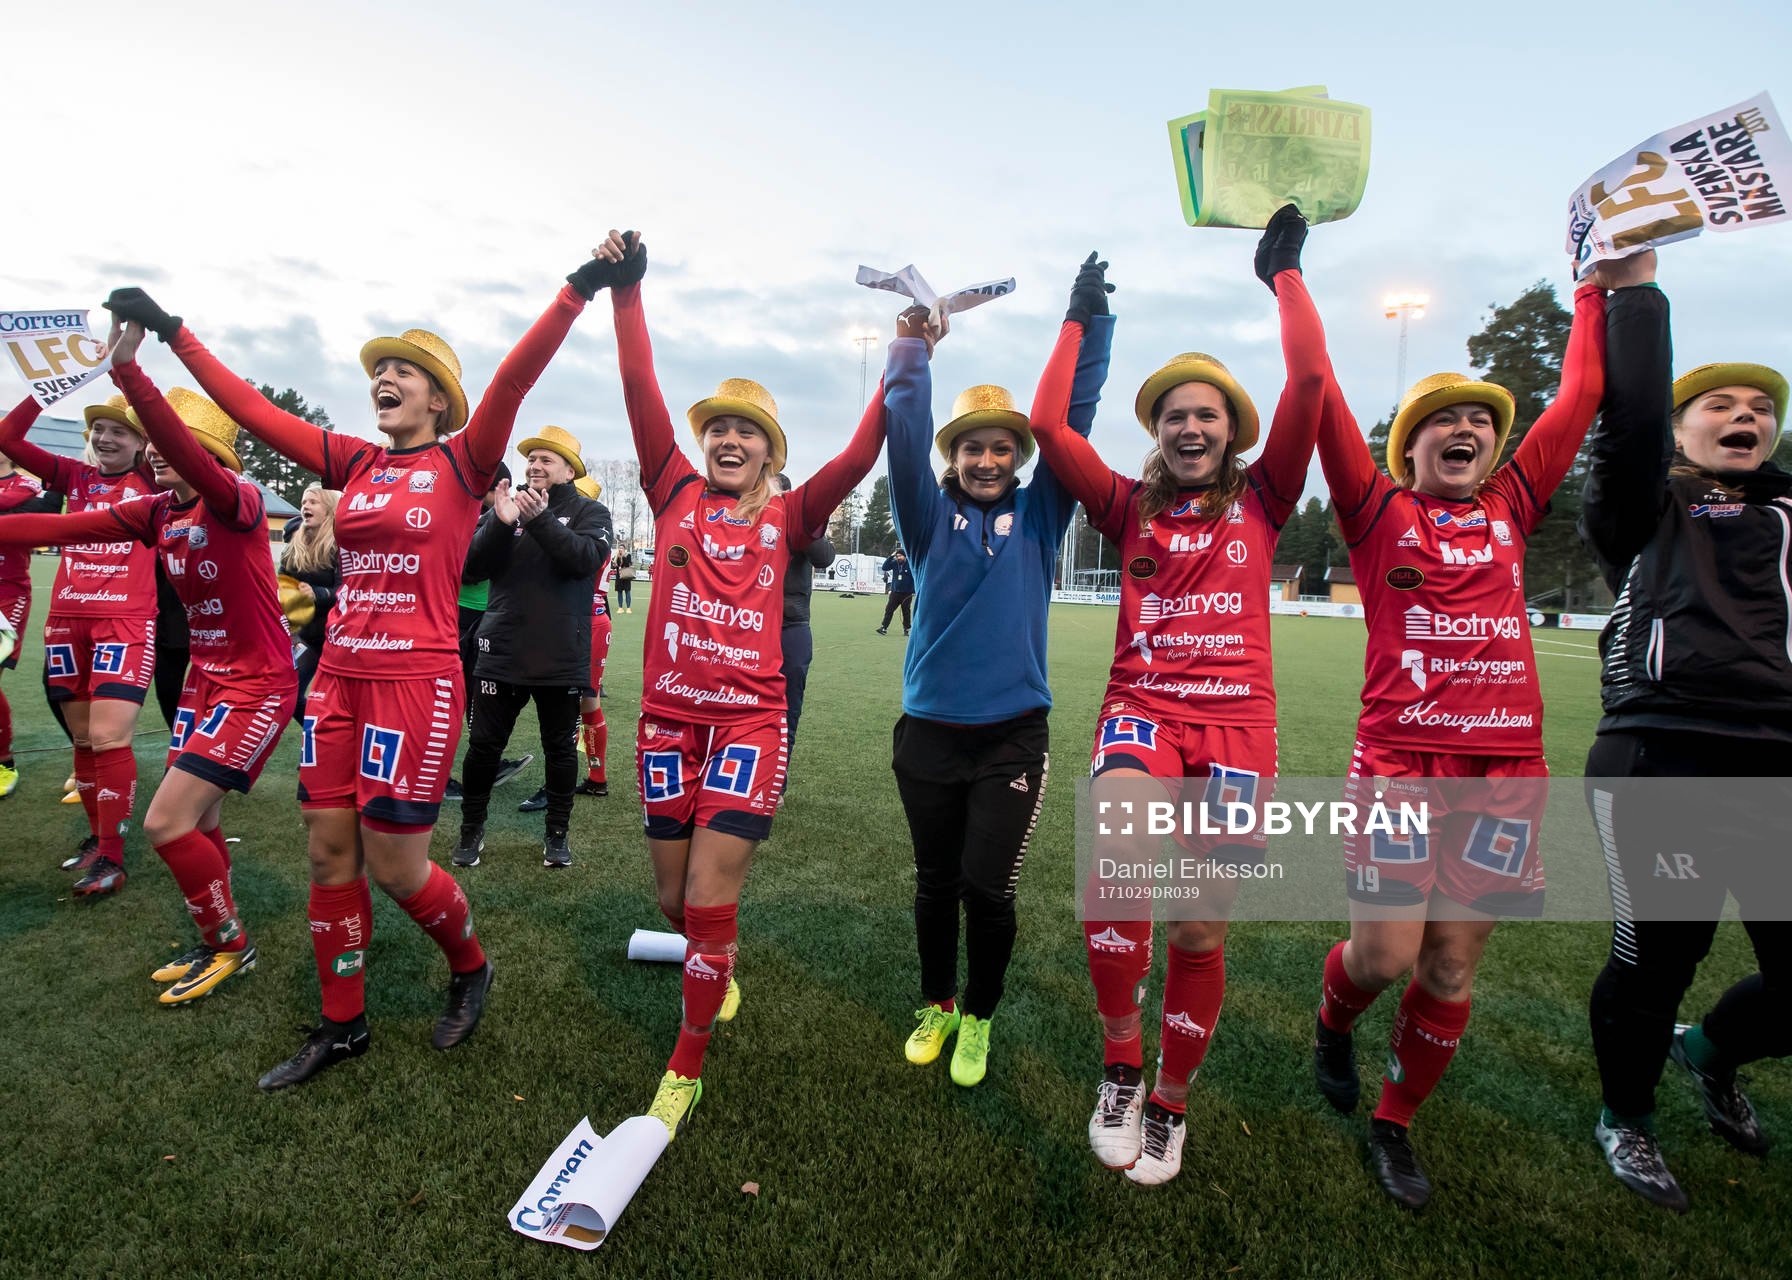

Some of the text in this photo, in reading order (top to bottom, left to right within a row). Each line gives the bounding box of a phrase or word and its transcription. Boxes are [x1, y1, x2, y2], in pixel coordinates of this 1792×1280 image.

[1670, 129, 1743, 225] SVENSKA
[1707, 117, 1786, 221] MÄSTARE
[0, 313, 83, 332] Corren
[8, 334, 100, 380] LFC
[352, 550, 420, 575] Botrygg
[58, 586, 128, 603] Korvgubbens
[689, 593, 764, 632] Botrygg
[1434, 613, 1520, 640] Botrygg
[328, 624, 414, 653] Korvgubbens
[681, 632, 760, 661] Riksbyggen
[1153, 632, 1244, 649] Riksbyggen
[1431, 657, 1525, 676] Riksbyggen
[481, 680, 497, 695] RB
[655, 670, 759, 705] Korvgubbens
[1399, 701, 1533, 733] Korvgubbens
[1356, 864, 1380, 893] 19
[1653, 852, 1700, 880] AR
